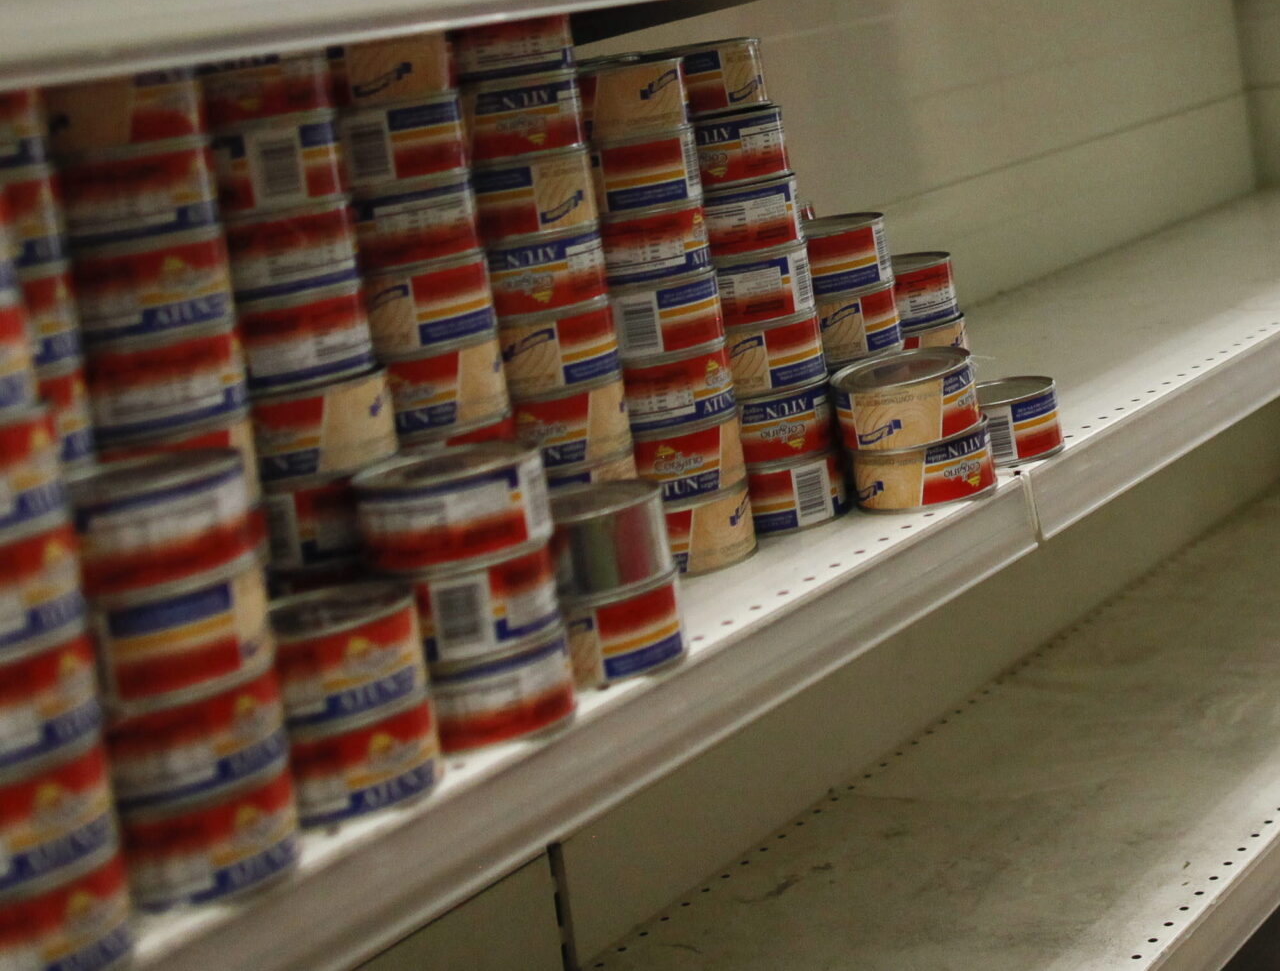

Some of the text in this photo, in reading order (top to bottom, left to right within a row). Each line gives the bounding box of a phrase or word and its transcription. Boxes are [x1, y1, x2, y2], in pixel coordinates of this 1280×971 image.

[699, 126, 732, 144] ATU
[506, 244, 558, 268] ATUN
[766, 396, 808, 421] ATUN
[946, 436, 982, 461] ATUN
[663, 475, 700, 499] TUN
